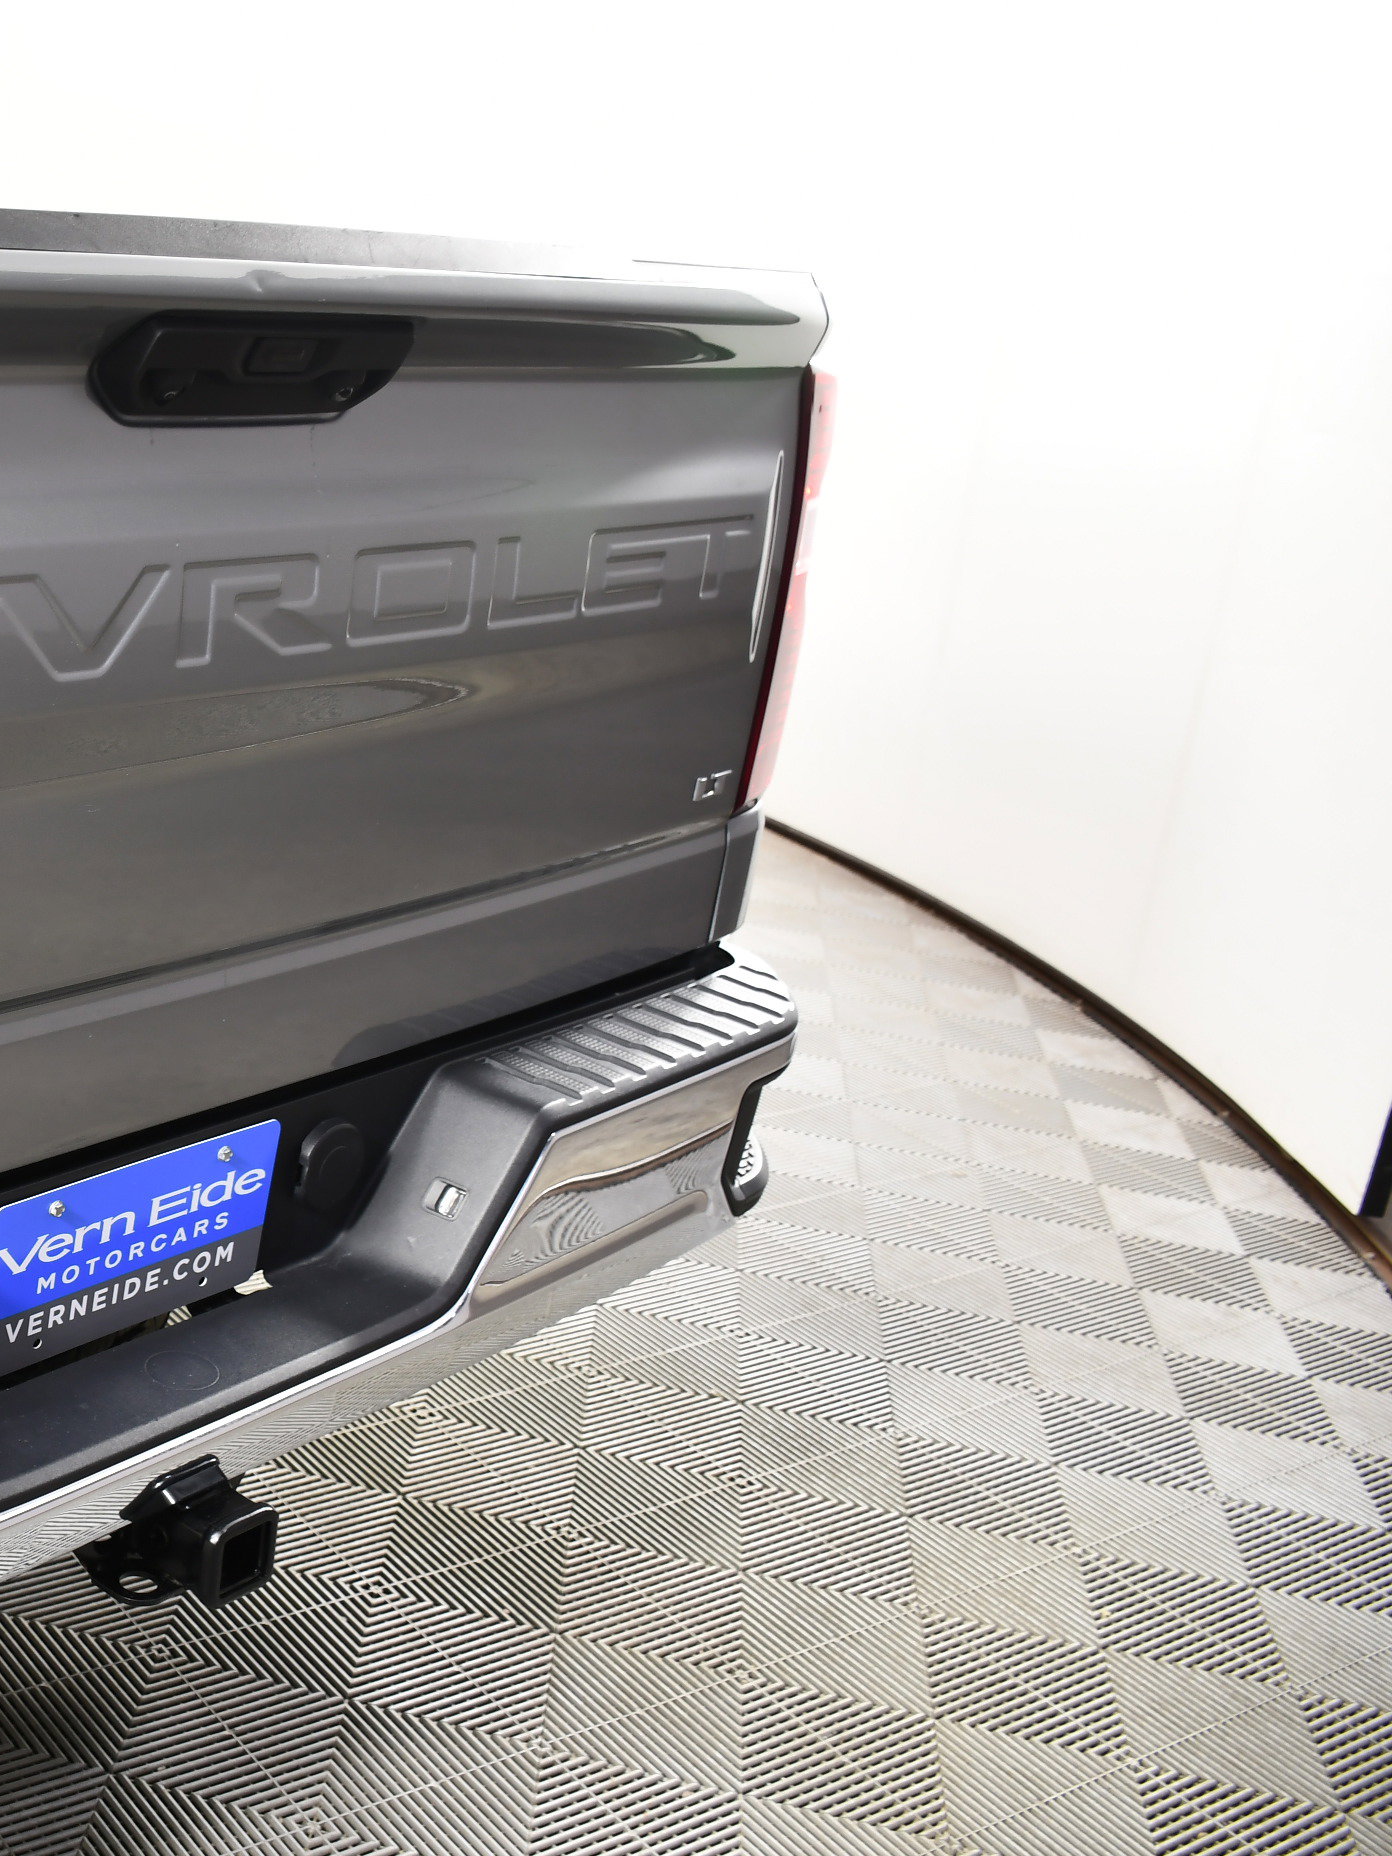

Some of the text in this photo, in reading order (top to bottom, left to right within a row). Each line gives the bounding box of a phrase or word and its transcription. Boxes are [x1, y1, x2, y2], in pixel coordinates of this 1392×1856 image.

[692, 769, 733, 802] LT
[149, 1168, 266, 1228] Eide
[35, 1211, 230, 1296] MOTORCARS
[4, 1241, 235, 1344] VERNEIDE.COM
